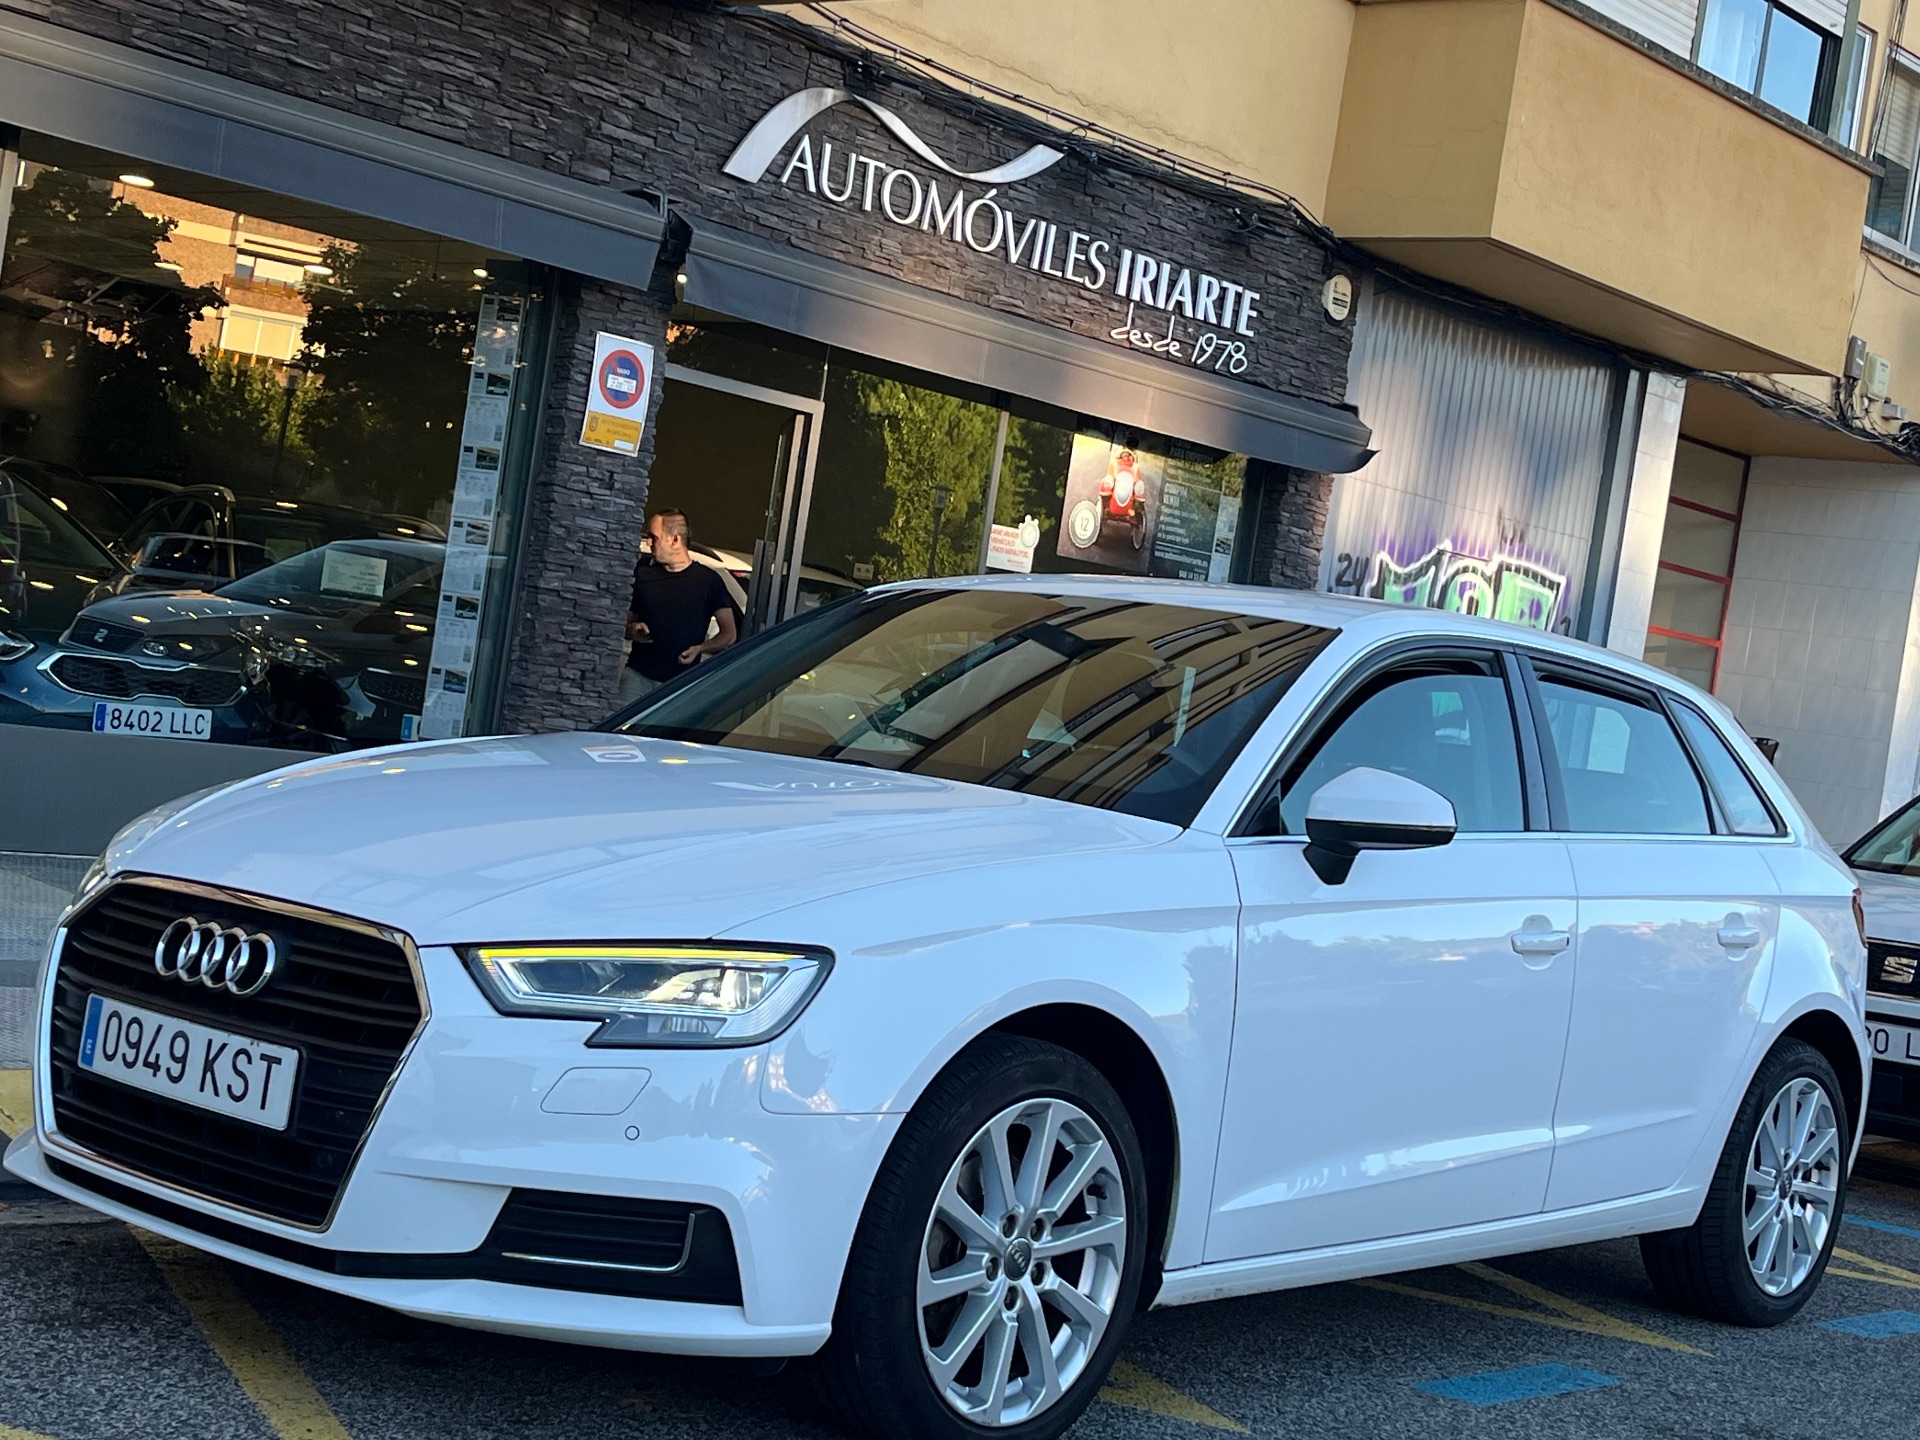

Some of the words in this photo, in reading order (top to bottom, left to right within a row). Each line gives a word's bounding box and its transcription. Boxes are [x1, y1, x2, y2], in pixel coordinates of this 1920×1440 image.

[780, 133, 1110, 290] AUTOMÓVILES
[1115, 249, 1261, 338] IRIARTE
[1110, 302, 1183, 357] desde
[1191, 333, 1248, 373] 1978
[110, 708, 163, 733] 8402
[169, 711, 206, 735] LLC
[102, 1010, 190, 1084] 0949
[199, 1038, 282, 1110] KST
